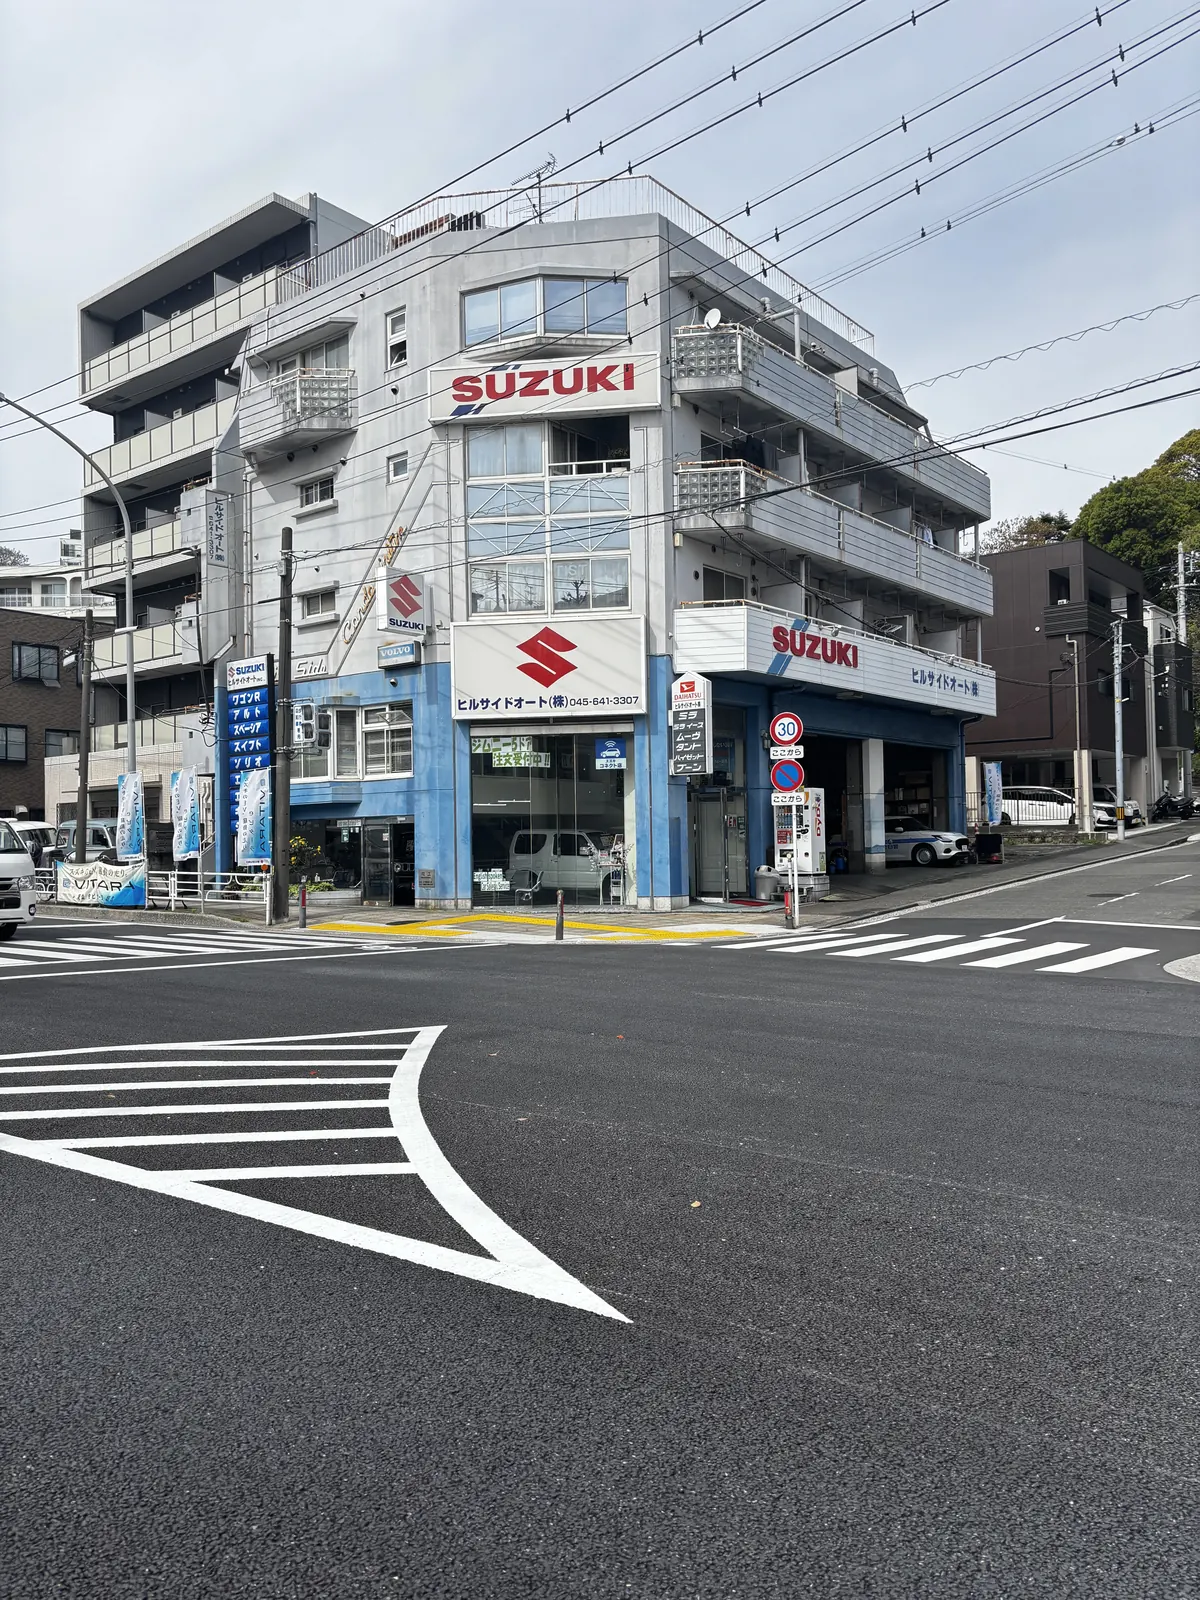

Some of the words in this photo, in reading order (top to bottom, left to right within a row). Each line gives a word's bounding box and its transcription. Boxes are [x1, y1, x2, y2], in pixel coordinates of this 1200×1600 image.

[452, 363, 635, 403] SUZUKI
[389, 618, 424, 631] SUZUKI
[380, 645, 411, 657] VOLVO
[772, 625, 858, 668] SUZUKI
[235, 663, 265, 675] SUZUKI
[232, 691, 261, 706] ワゴンR
[457, 695, 568, 711] ヒルサイドオート(株)
[569, 696, 639, 707] 045-641-3307
[674, 692, 702, 701] DAIHATSU
[233, 706, 261, 720] アルト
[678, 711, 698, 720] ミラ
[777, 721, 796, 737] 30
[676, 731, 701, 741] ムーヴ
[233, 740, 262, 753] スイフト
[676, 742, 702, 751] タント
[772, 749, 802, 757] ここから
[234, 755, 262, 769] ソリオ
[773, 795, 803, 803] ここから
[74, 878, 135, 891] VITARA
